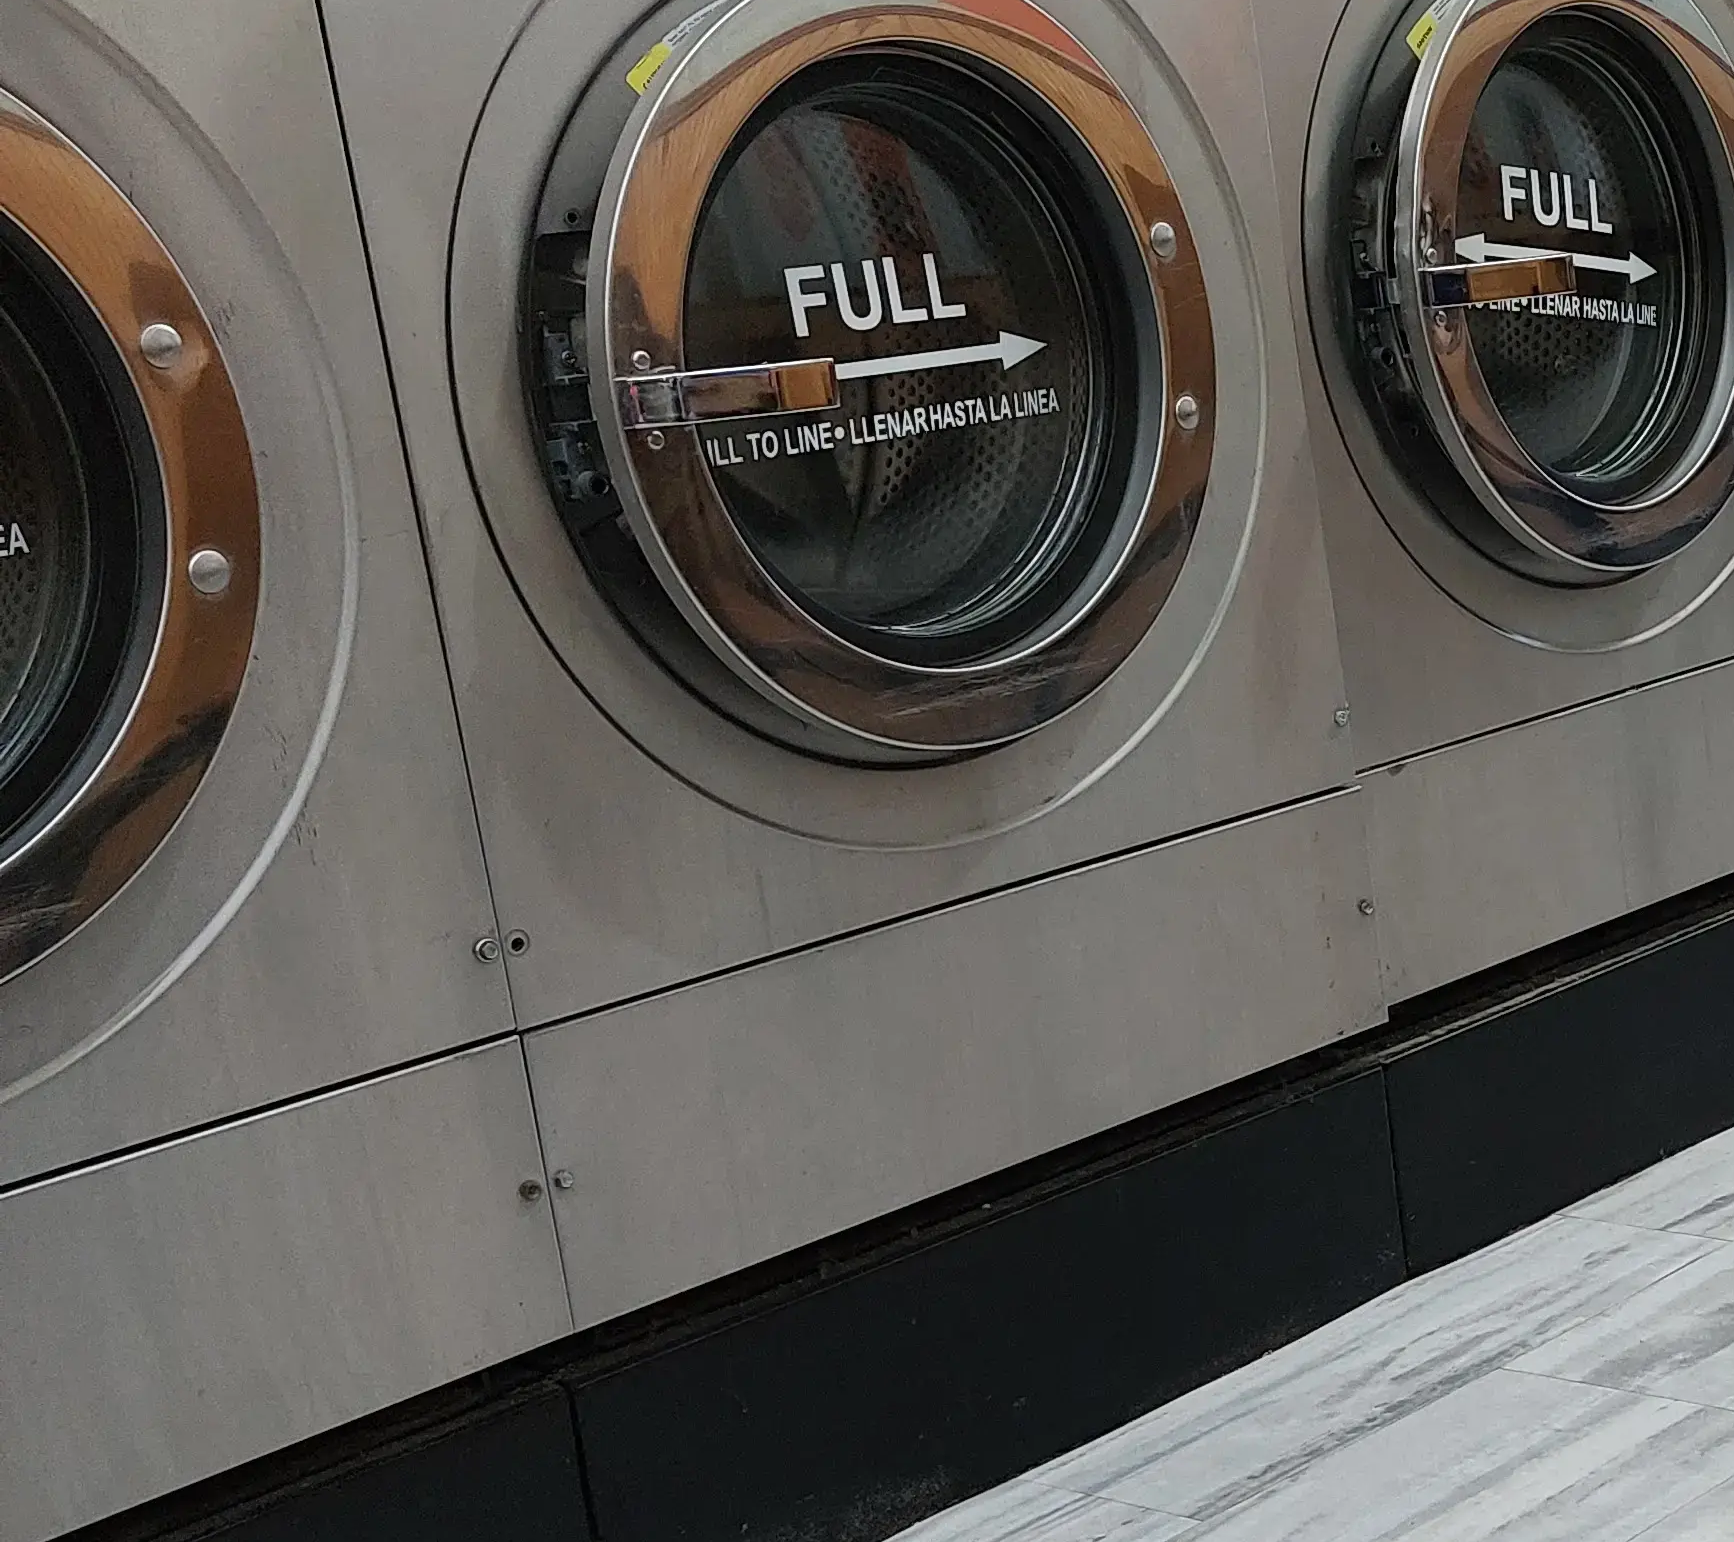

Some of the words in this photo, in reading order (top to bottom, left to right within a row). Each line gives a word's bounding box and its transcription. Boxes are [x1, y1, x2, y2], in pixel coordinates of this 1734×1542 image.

[1499, 163, 1614, 234] FULL
[783, 253, 967, 338] FULL
[1531, 294, 1581, 319] LLENAR
[1583, 297, 1620, 323] HASTA
[1621, 302, 1634, 325] LA
[1637, 304, 1657, 327] LINE
[706, 436, 744, 467] ILL
[746, 430, 779, 460] TO
[784, 422, 835, 455] LINE
[849, 407, 929, 445] LLENAR
[929, 397, 988, 431] HASTA
[989, 394, 1012, 422] LA
[1013, 387, 1060, 419] LINEA
